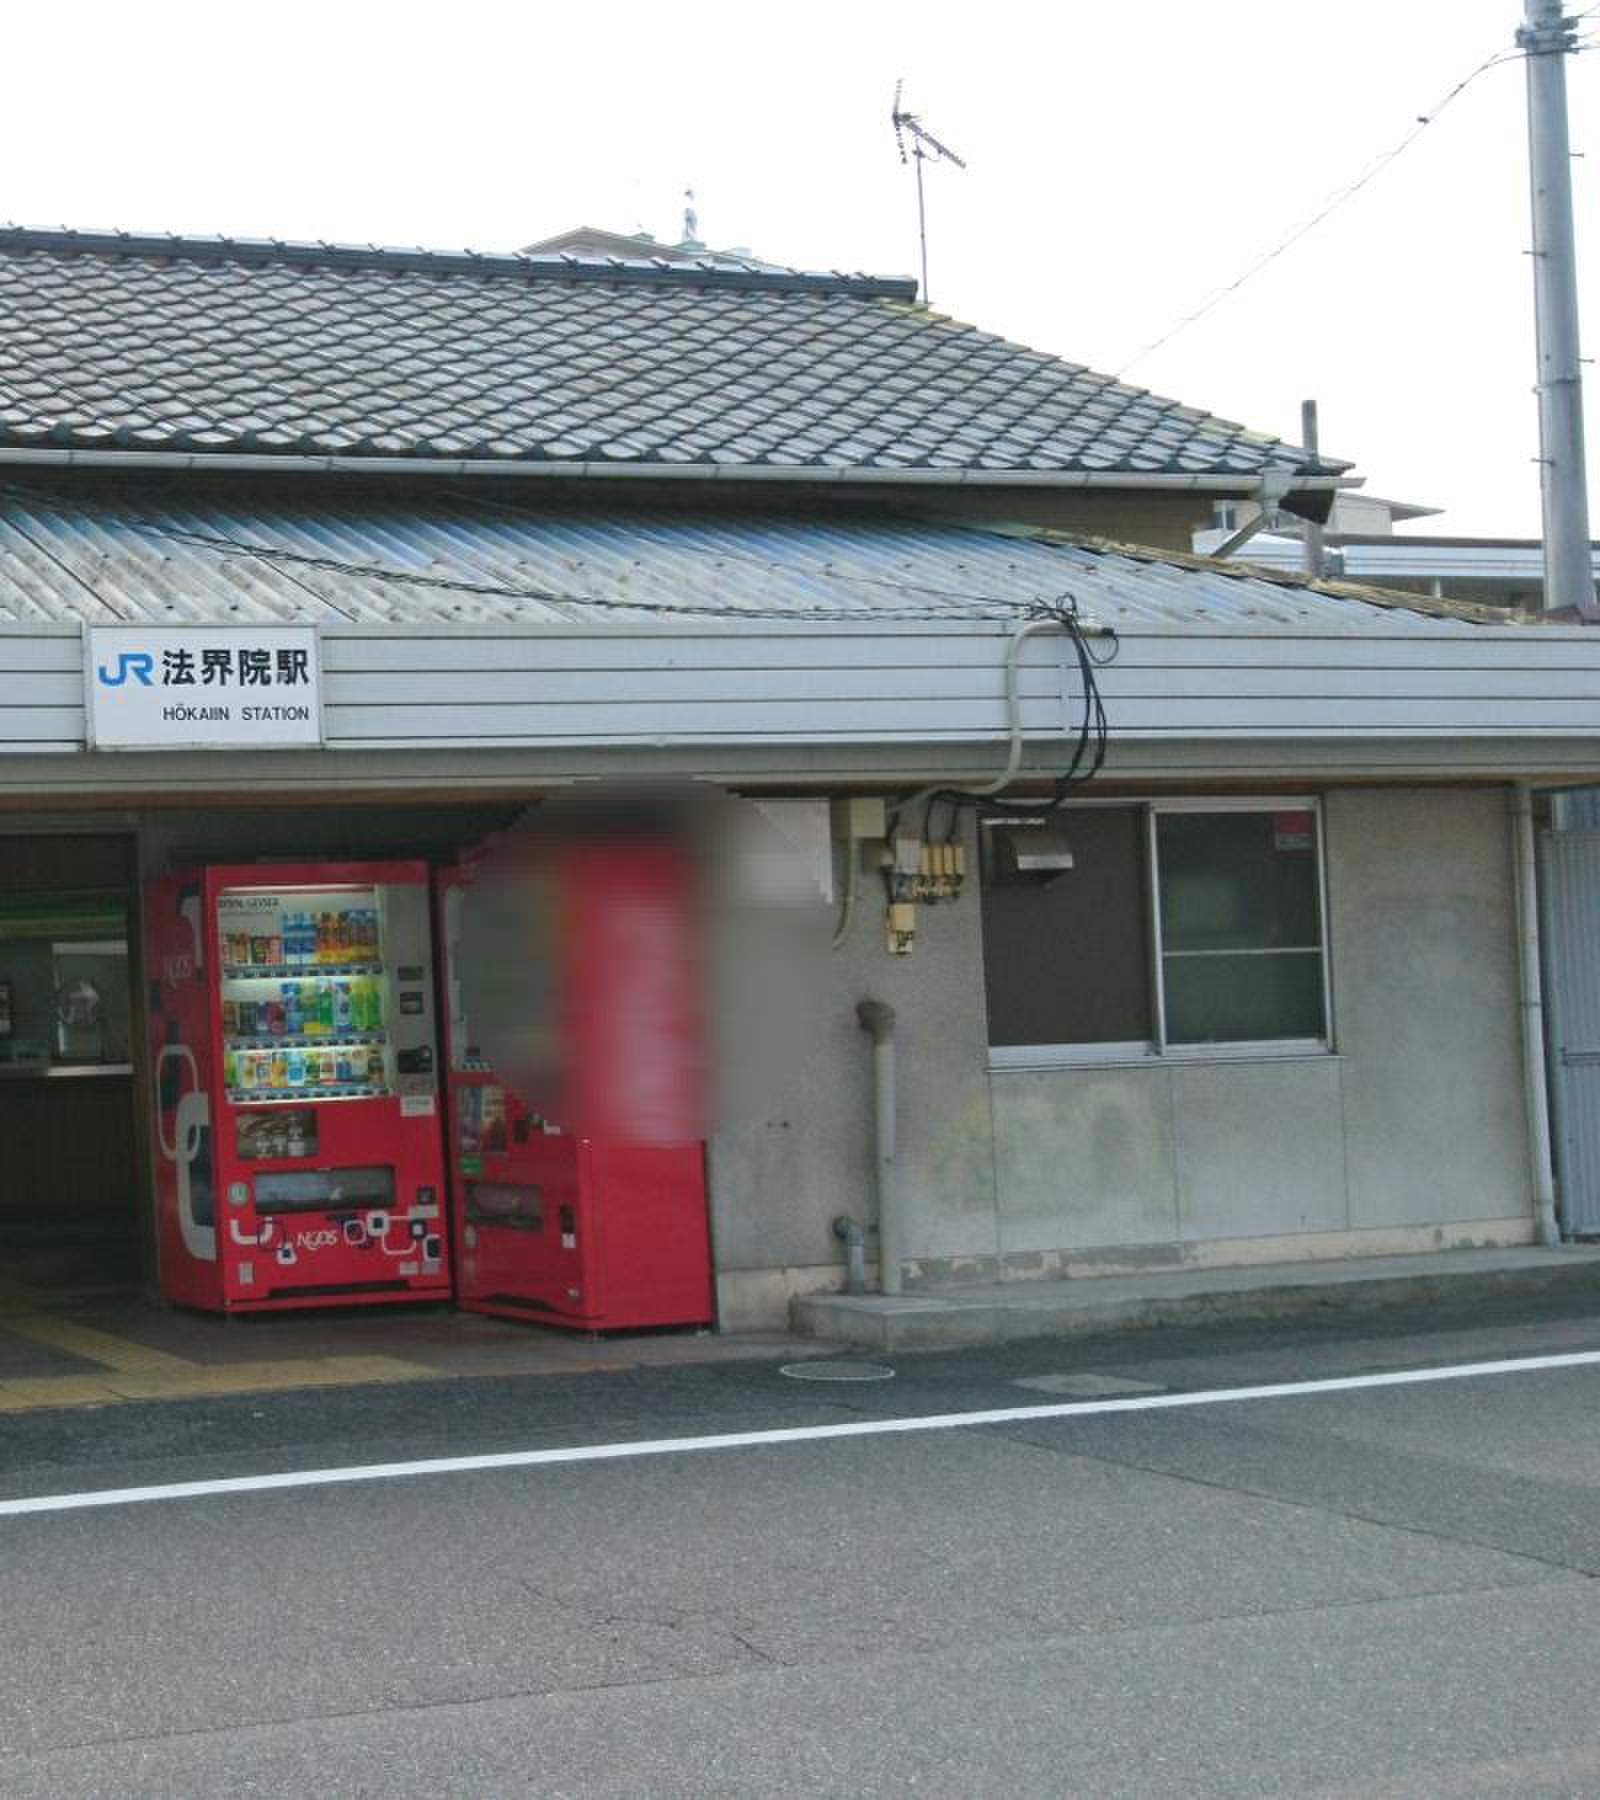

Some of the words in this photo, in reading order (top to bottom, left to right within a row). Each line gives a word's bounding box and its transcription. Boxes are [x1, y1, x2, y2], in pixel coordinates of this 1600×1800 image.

[99, 654, 153, 686] JR
[162, 649, 309, 686] 法界院駅
[241, 706, 309, 720] STATION
